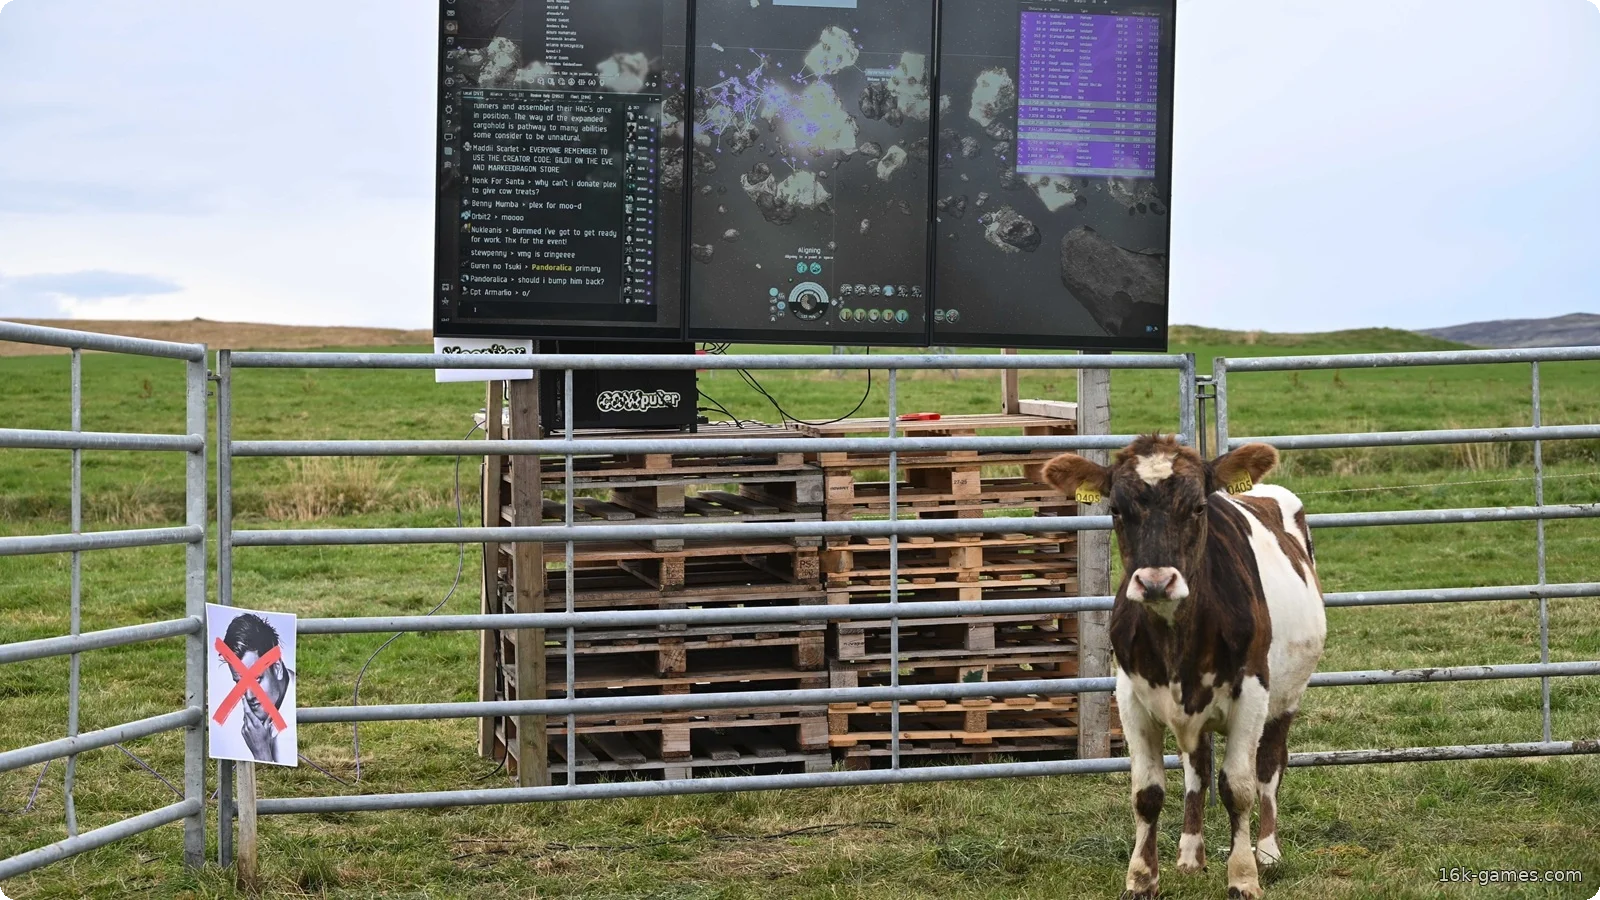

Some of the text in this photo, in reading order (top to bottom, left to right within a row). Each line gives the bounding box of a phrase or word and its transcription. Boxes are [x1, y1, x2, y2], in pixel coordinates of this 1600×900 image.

[518, 103, 554, 112] assembled
[557, 104, 572, 112] their
[575, 105, 593, 113] HAC's
[483, 112, 512, 121] position.
[571, 115, 603, 123] expanded
[473, 122, 505, 131] cargohold
[517, 124, 546, 132] pathway
[581, 125, 607, 133] abilities
[495, 132, 523, 140] consider
[497, 145, 519, 153] Scarlet
[529, 146, 561, 154] EVERYONE
[564, 147, 597, 155] REMEMBER
[503, 155, 531, 163] CREATOR
[587, 157, 598, 165] THE
[601, 158, 613, 166] EVE
[488, 164, 537, 173] MARKEEDRAGON
[472, 177, 488, 185] Honk
[491, 177, 502, 185] For
[505, 178, 524, 186] Santa
[535, 179, 548, 188] why
[552, 179, 568, 187] can't
[577, 180, 599, 188] donate
[603, 180, 617, 189] plex
[483, 187, 496, 196] give
[515, 187, 539, 196] treats?
[472, 200, 492, 209] Benny
[529, 201, 543, 210] plex
[559, 202, 582, 210] moo-d
[512, 227, 541, 235] Bummed
[559, 229, 570, 237] got
[598, 229, 617, 238] ready
[471, 236, 480, 244] for
[533, 237, 544, 245] the
[471, 250, 507, 258] stewpenny
[798, 247, 821, 255] Aligning
[471, 262, 490, 270] Guren
[575, 265, 601, 273] primary
[470, 275, 507, 283] Pandoralica
[548, 277, 567, 286] bump
[570, 277, 583, 285] him
[470, 289, 481, 297] Cpt
[522, 290, 530, 298] o/
[1228, 480, 1252, 495] 0405
[1076, 493, 1100, 502] 0405
